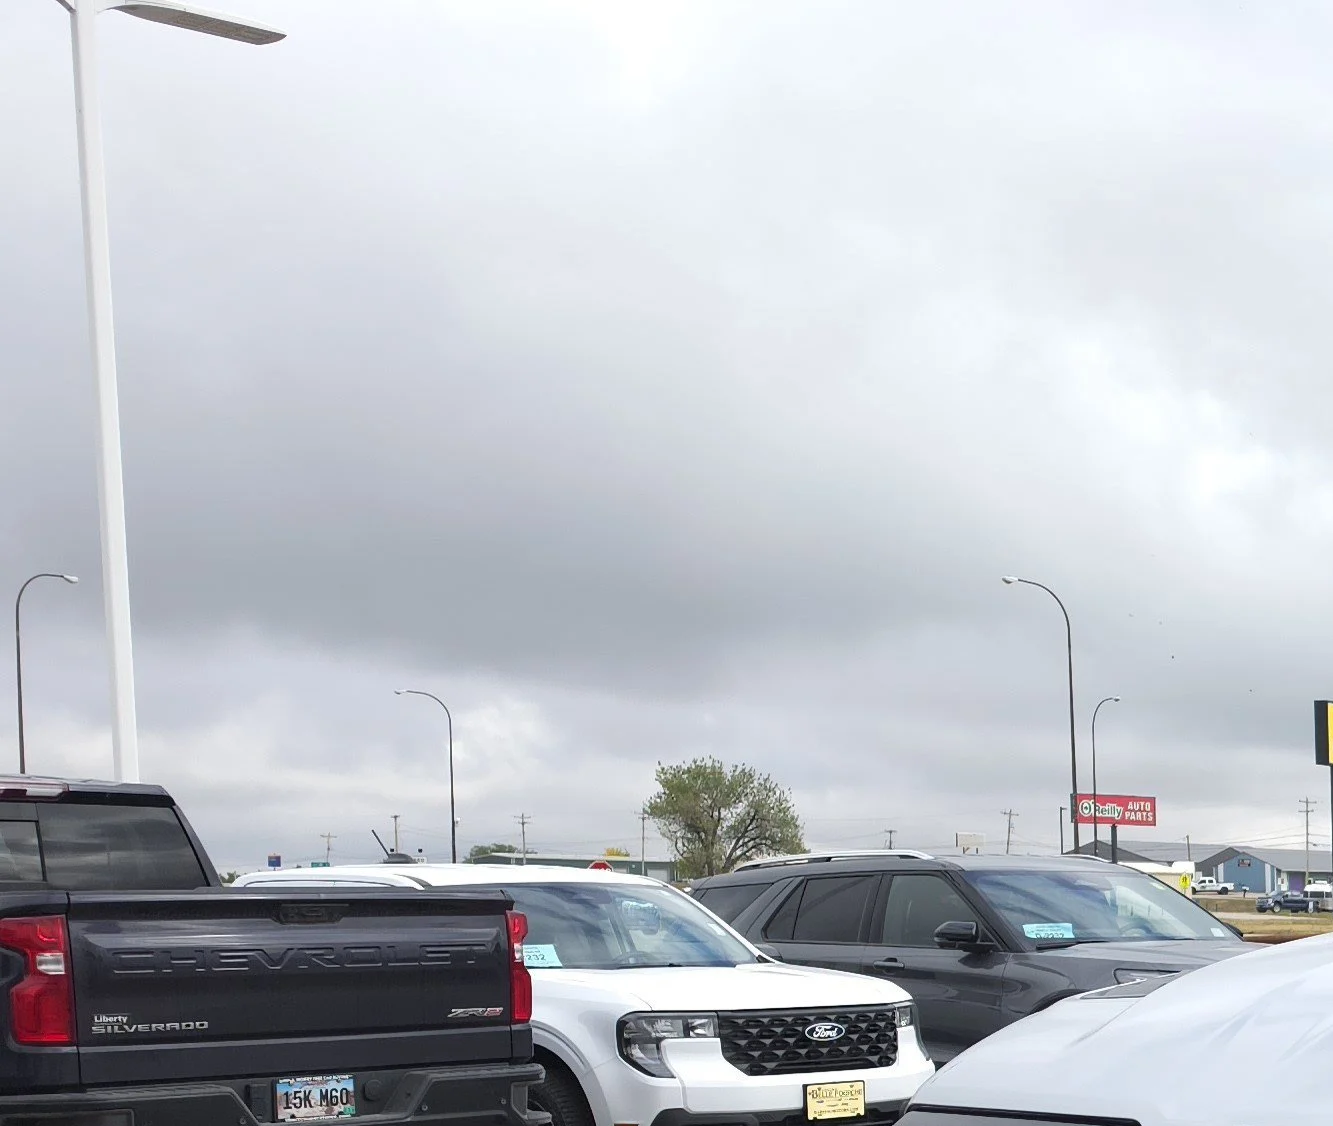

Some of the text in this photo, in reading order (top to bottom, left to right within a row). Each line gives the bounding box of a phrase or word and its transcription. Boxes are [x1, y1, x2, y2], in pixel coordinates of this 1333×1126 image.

[1079, 800, 1123, 819] O'Reilly
[1127, 801, 1151, 811] AUTO
[1125, 811, 1153, 822] PARTS
[112, 944, 491, 974] CHEVROLET
[94, 1014, 128, 1024] Liberty
[92, 1021, 209, 1034] SILVERADO
[812, 1025, 838, 1038] Ford
[283, 1089, 313, 1110] 15K
